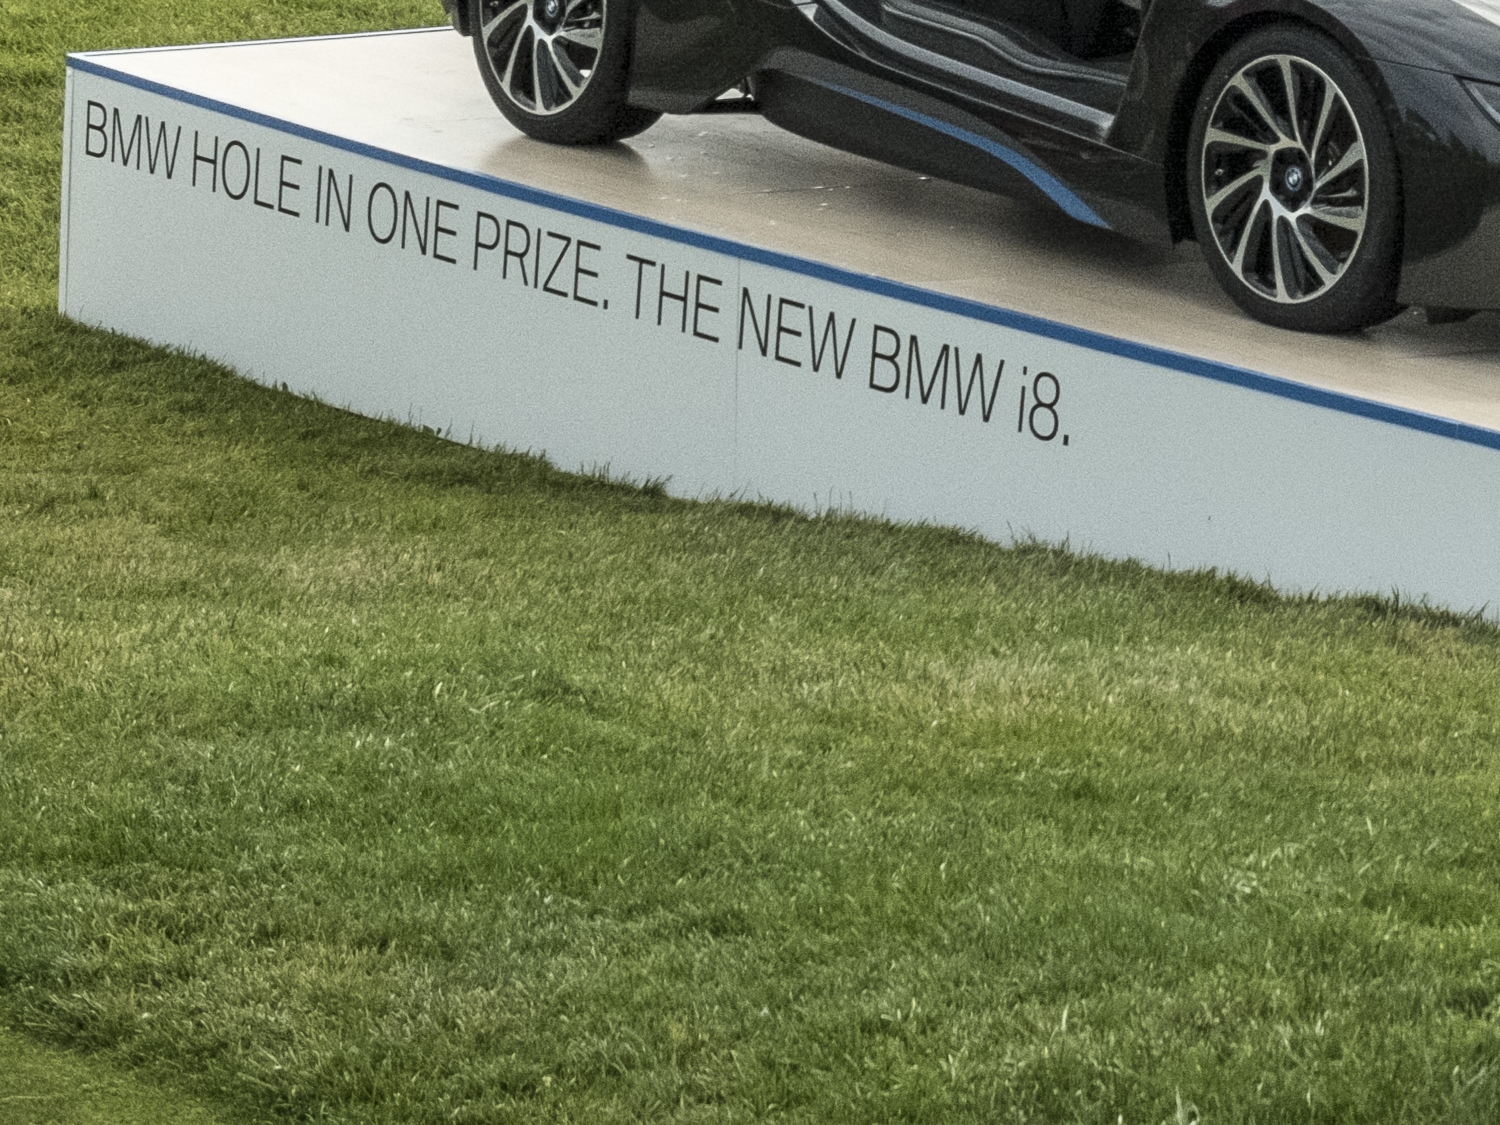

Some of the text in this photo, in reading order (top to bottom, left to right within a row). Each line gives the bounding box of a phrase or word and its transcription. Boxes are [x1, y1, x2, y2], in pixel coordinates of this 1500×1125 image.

[85, 99, 1071, 446] BMW HOLE IN ONE PRIZE. THE NEW BMW i8.
